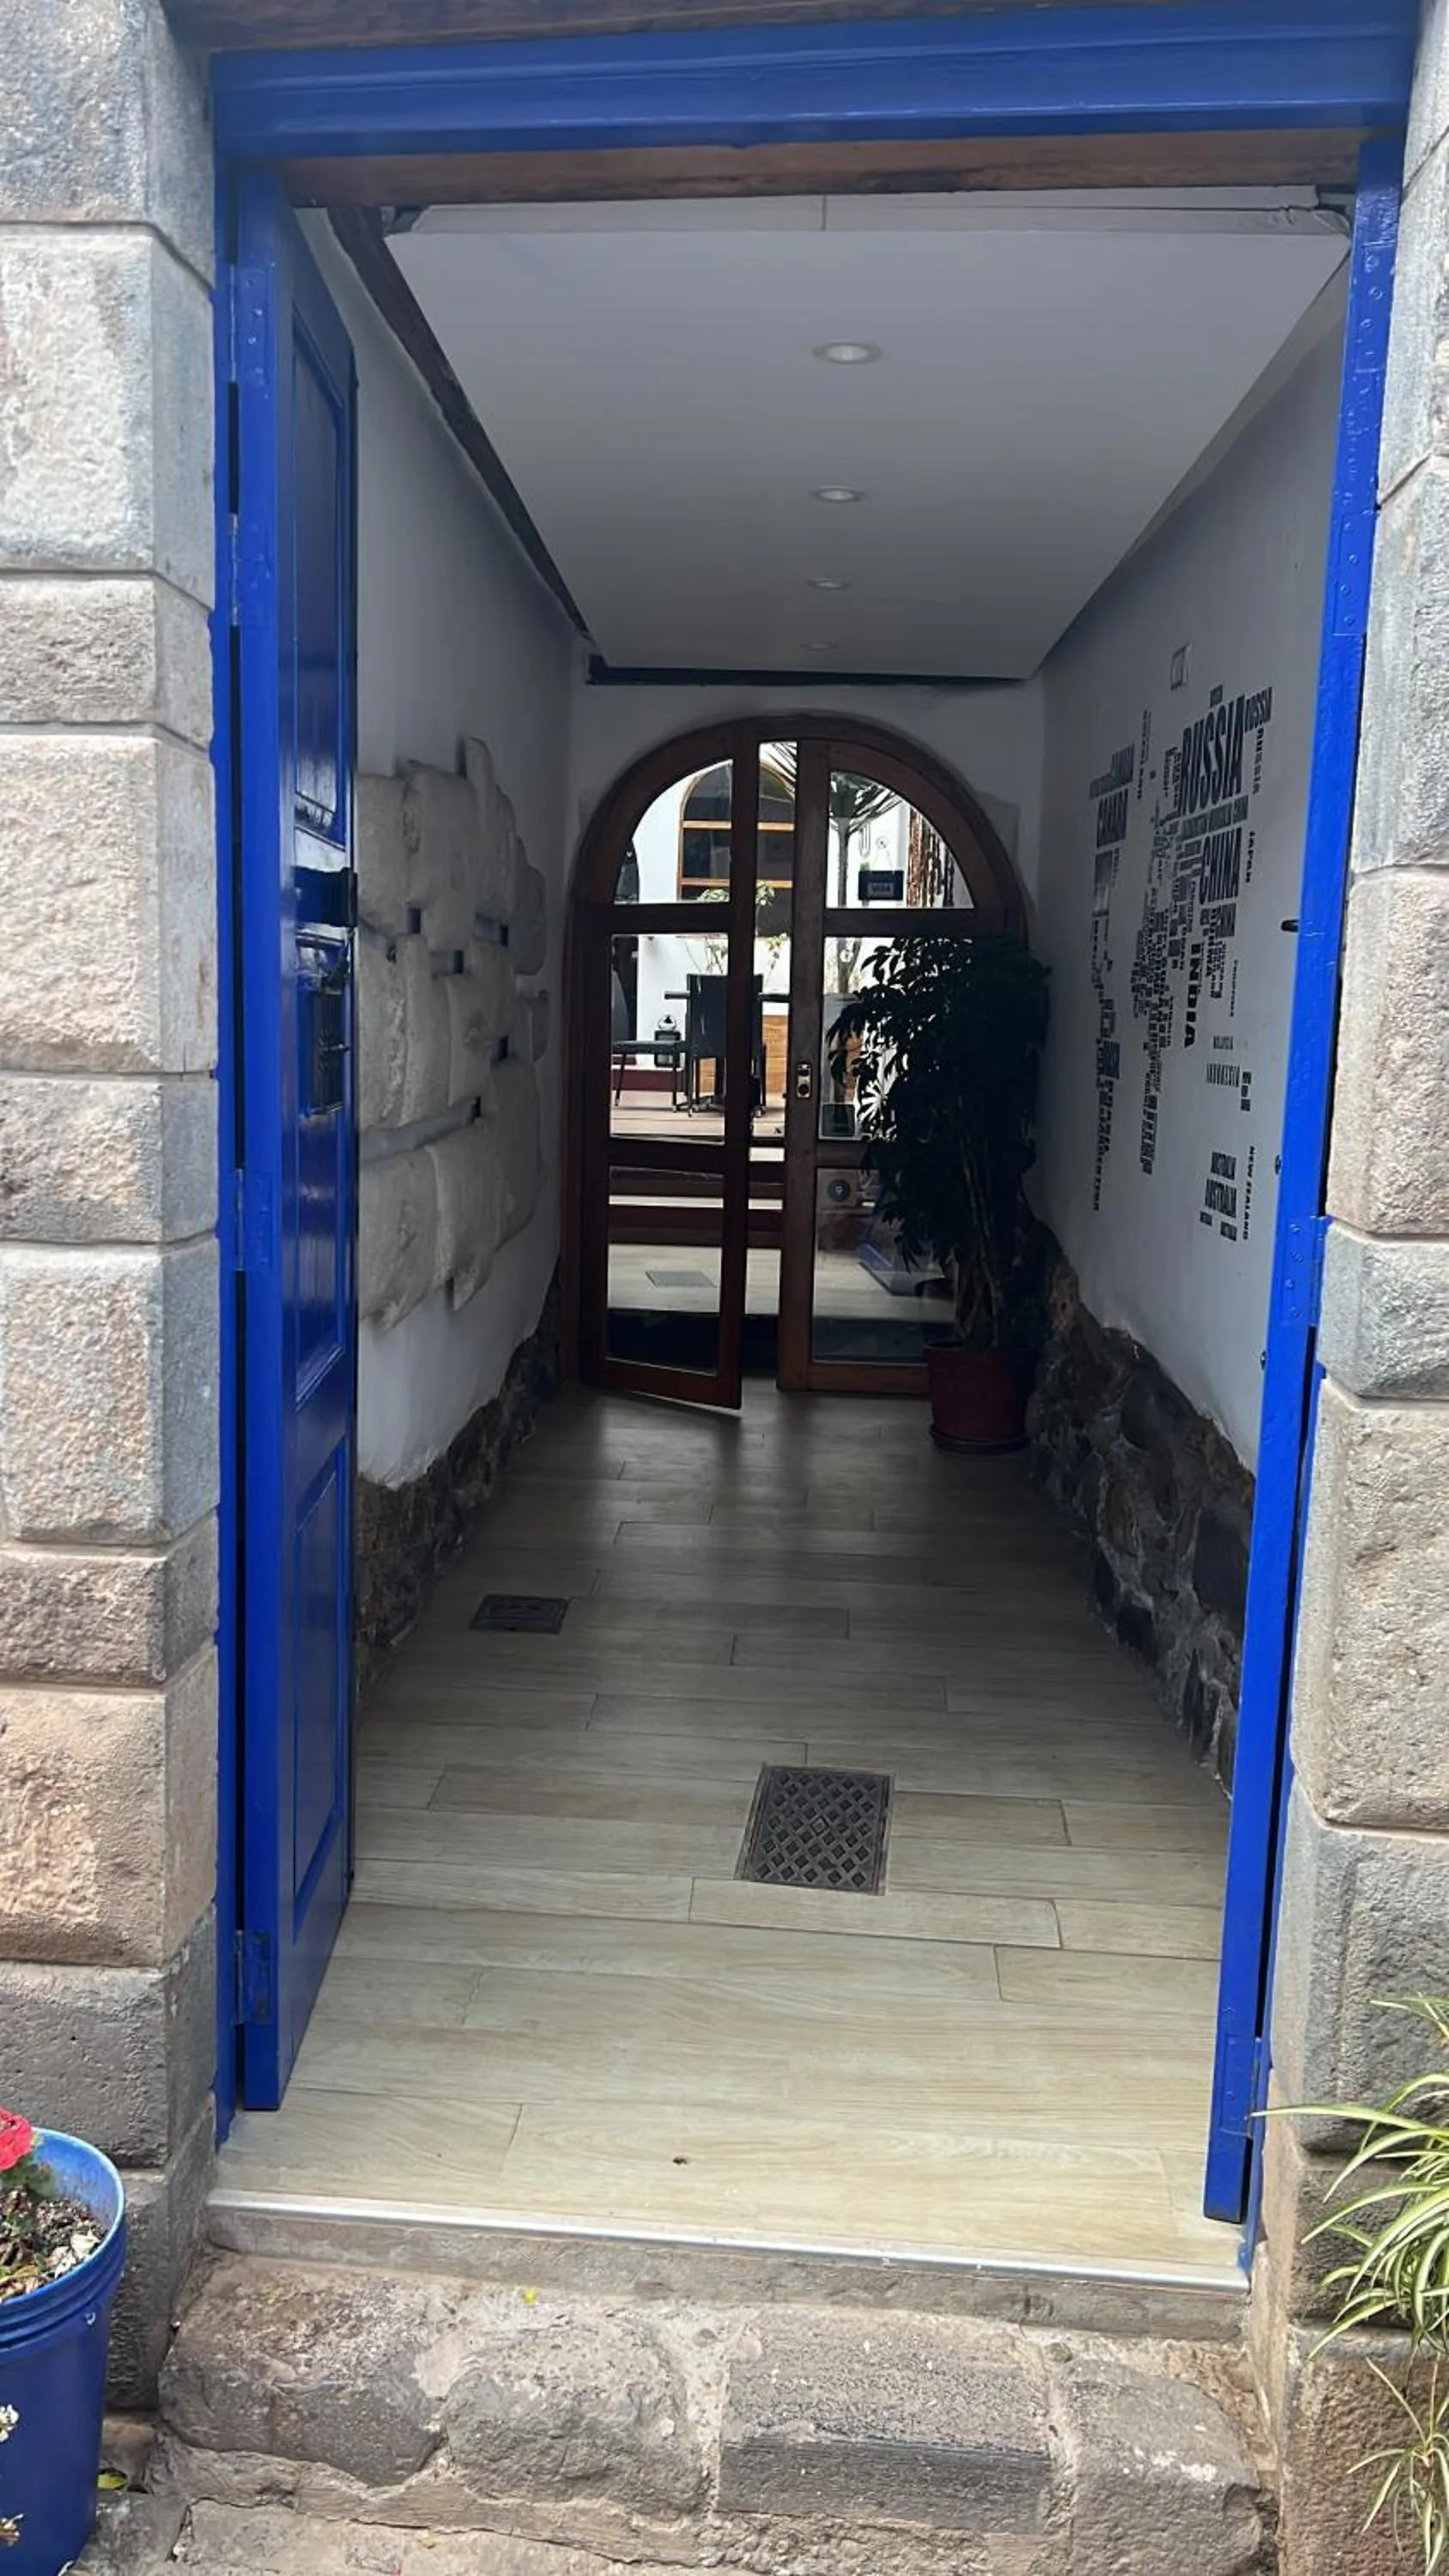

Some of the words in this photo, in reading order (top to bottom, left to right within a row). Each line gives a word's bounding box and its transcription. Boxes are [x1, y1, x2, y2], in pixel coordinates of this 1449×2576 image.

[1179, 694, 1245, 817] RUSSIA
[1198, 827, 1242, 905] CHINA
[1184, 943, 1202, 1048] INDIA
